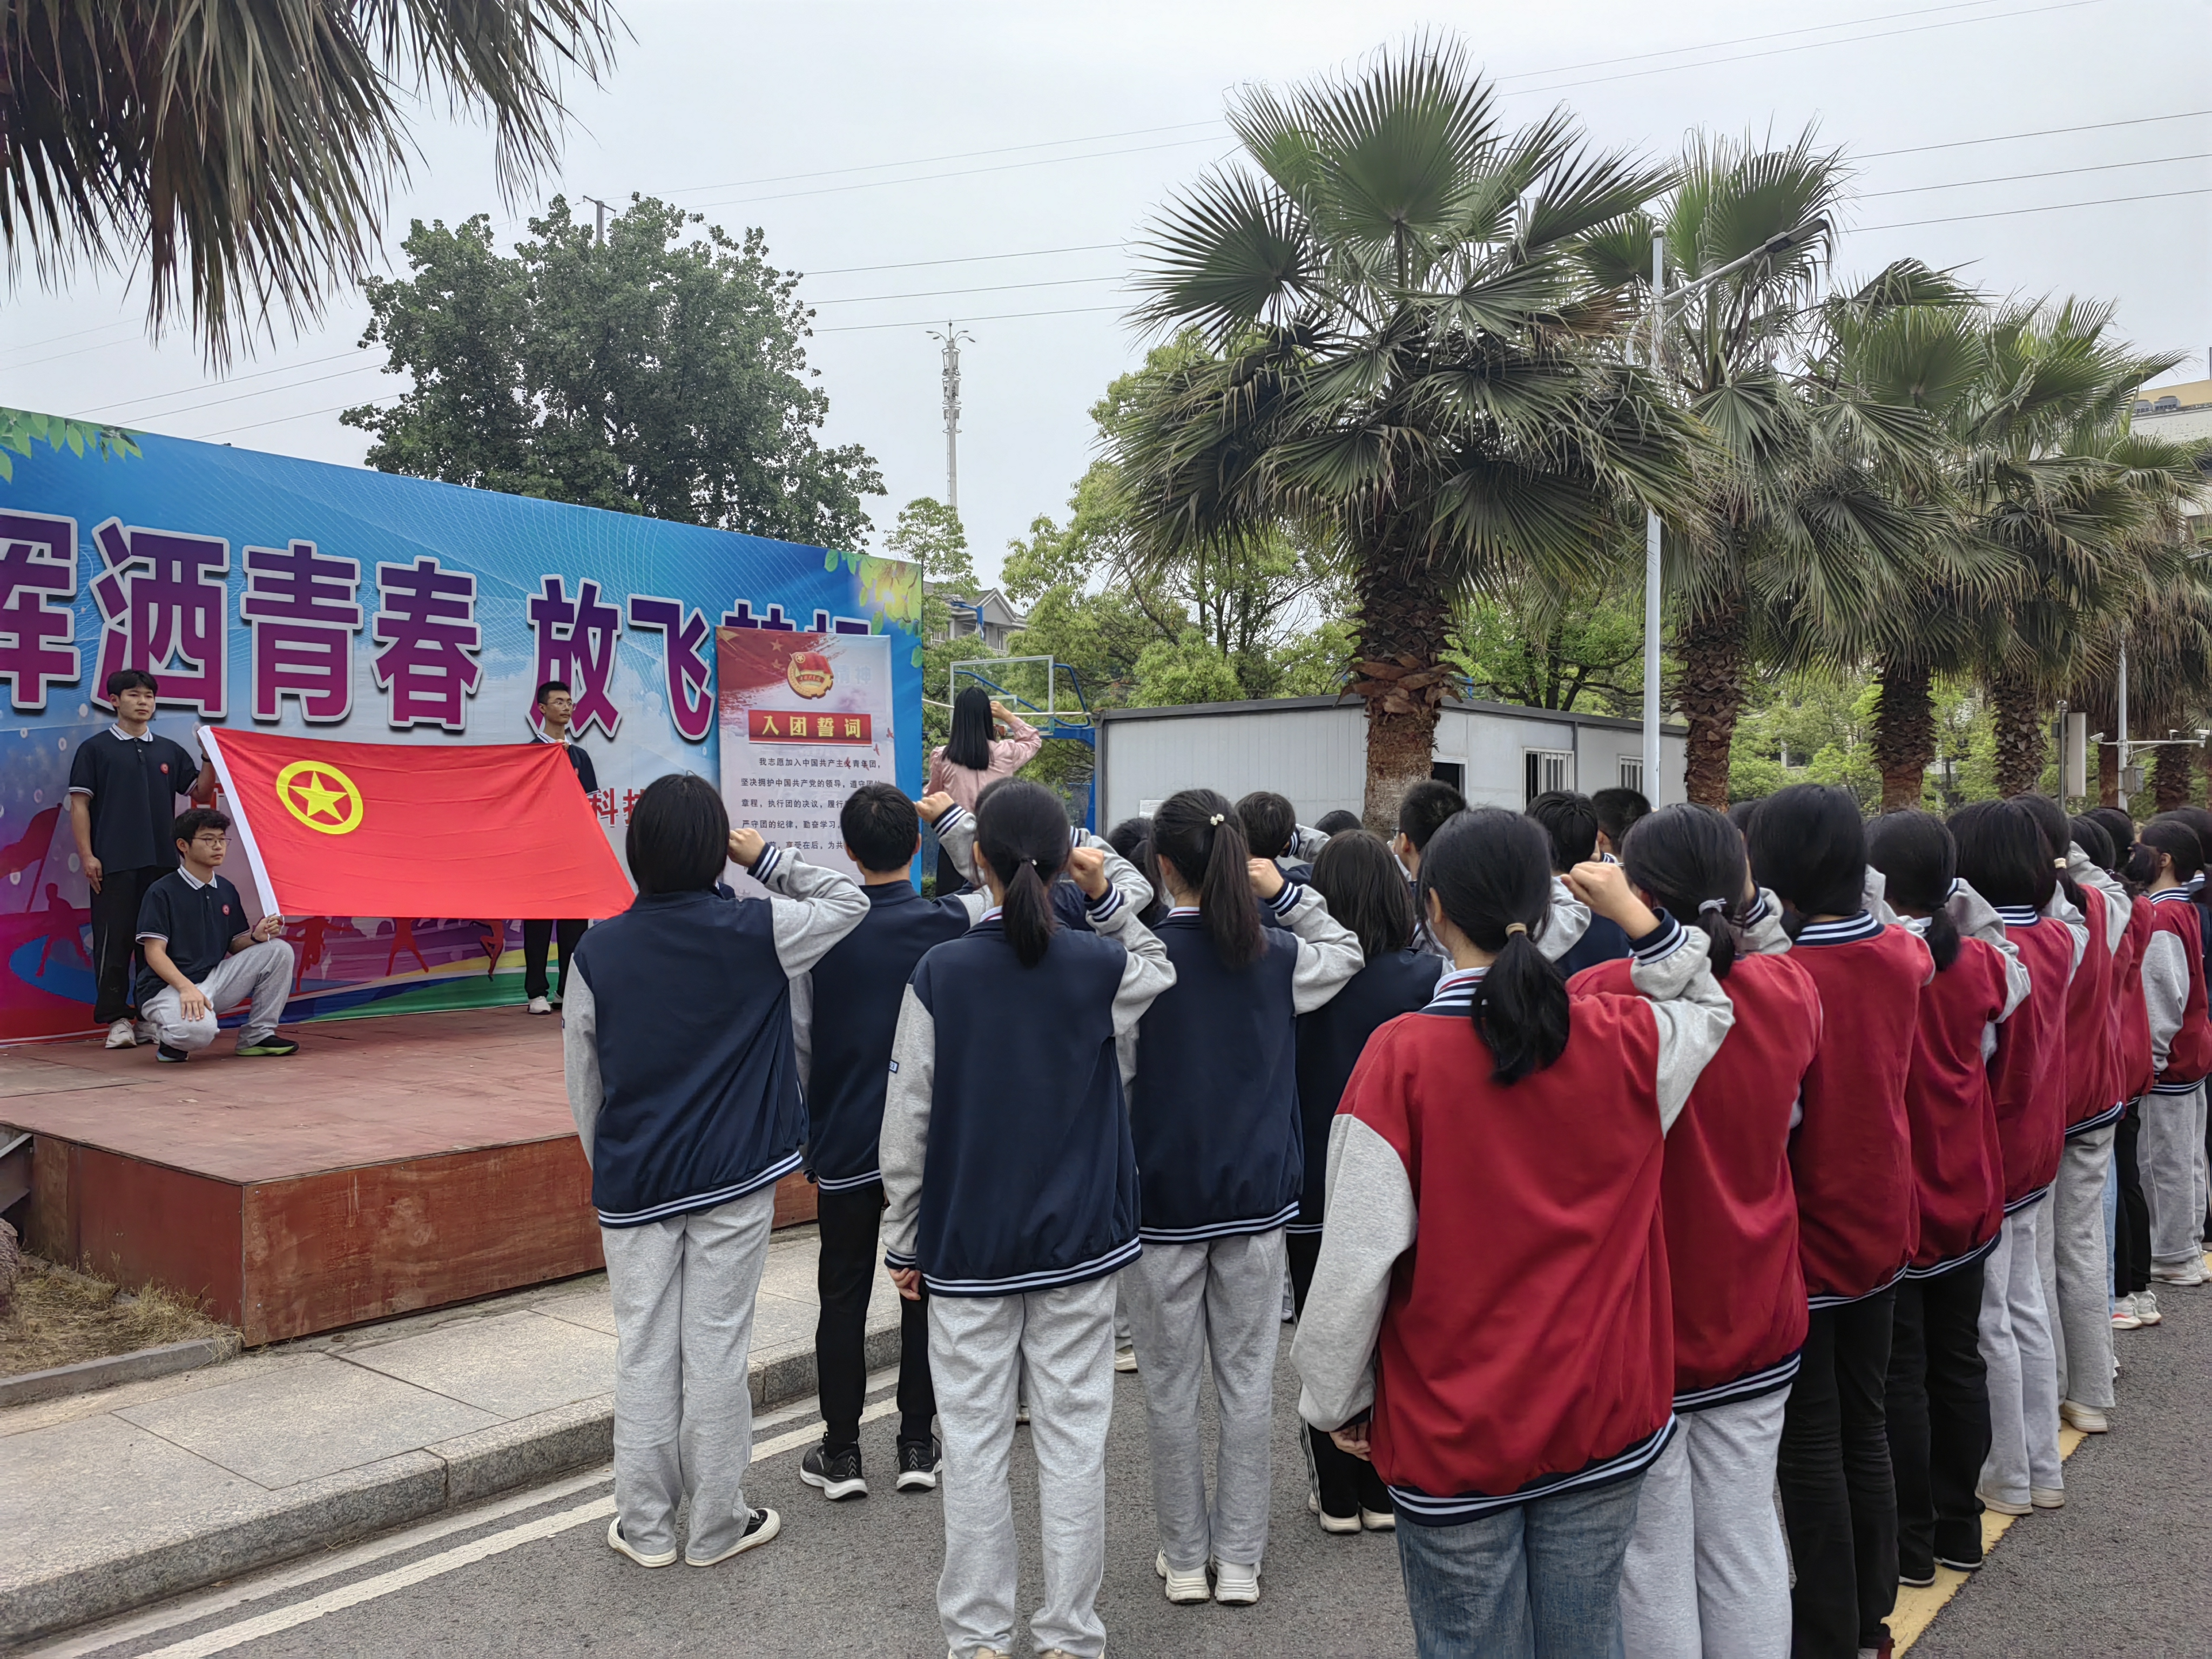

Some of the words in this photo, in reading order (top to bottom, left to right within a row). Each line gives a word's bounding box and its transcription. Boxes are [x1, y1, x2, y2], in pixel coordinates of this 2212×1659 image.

[526, 574, 872, 740] 放飞
[762, 716, 861, 738] 入团誓词
[741, 799, 848, 809] 章程，执行团的决议，履行
